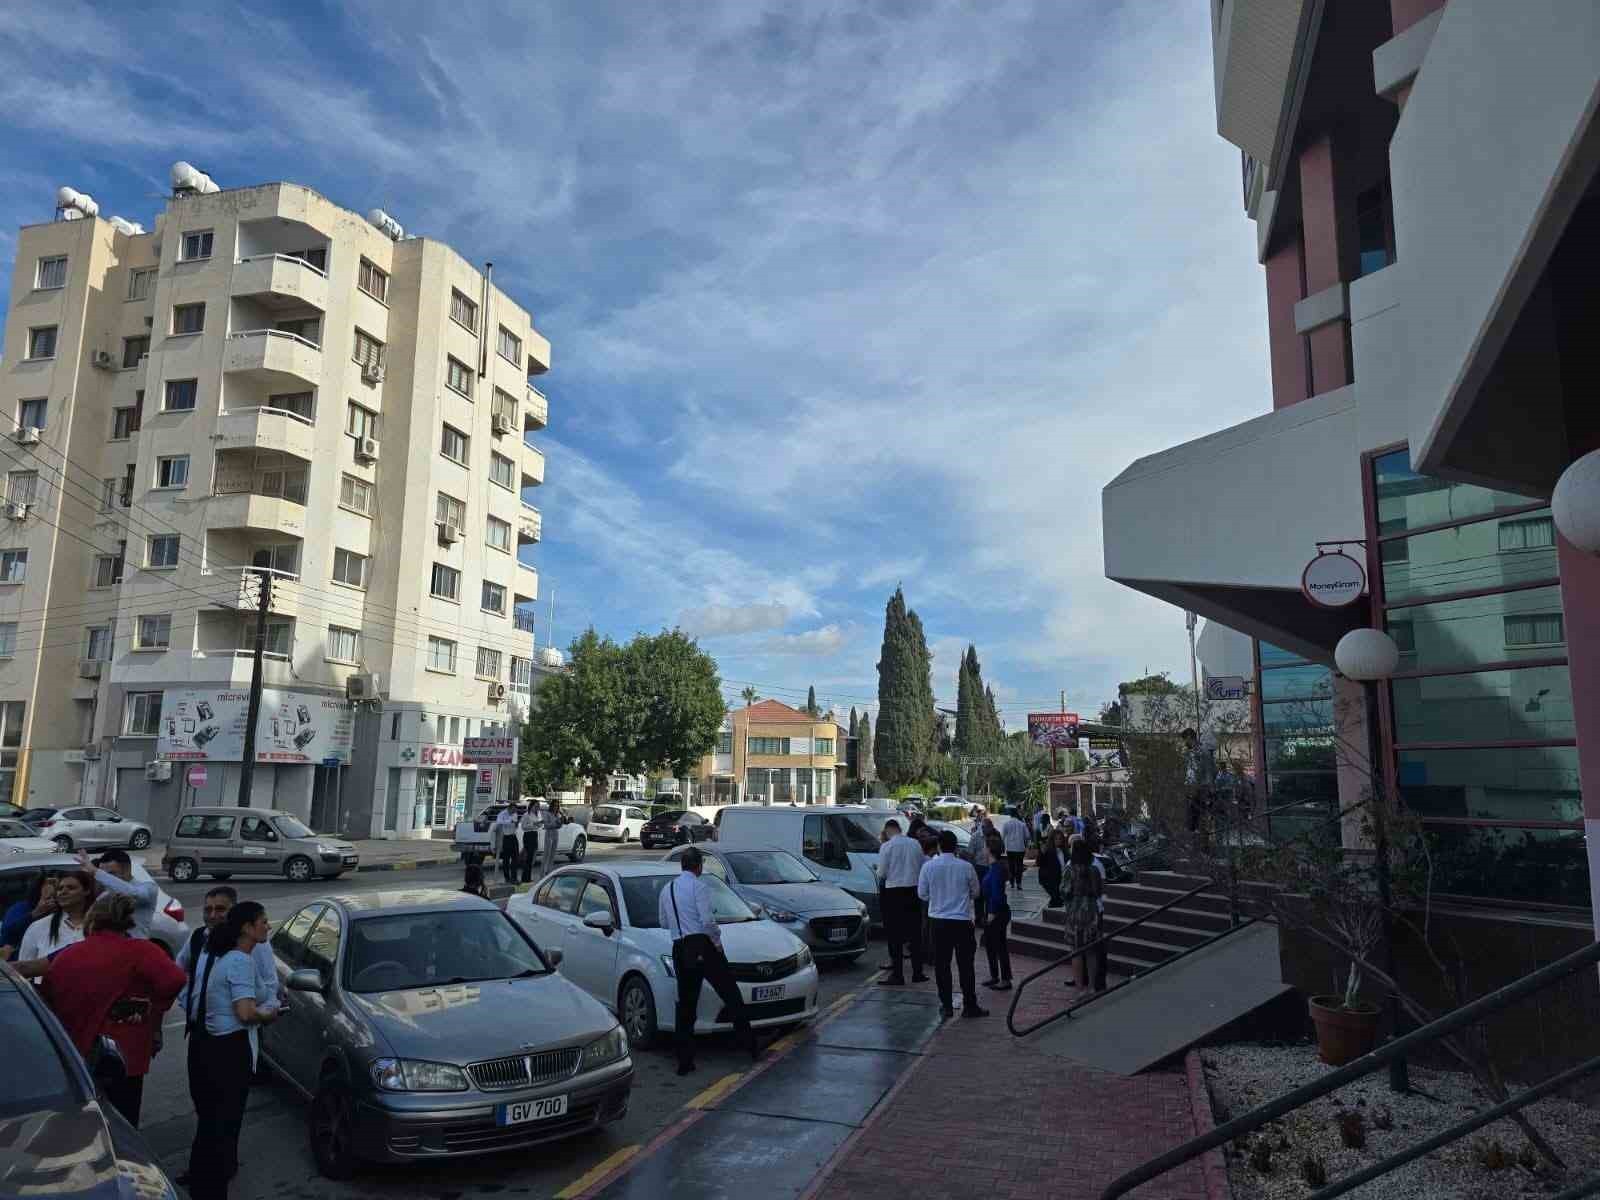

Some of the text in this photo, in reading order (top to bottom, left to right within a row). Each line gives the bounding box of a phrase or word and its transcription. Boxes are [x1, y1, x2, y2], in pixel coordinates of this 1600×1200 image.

[464, 738, 512, 748] ECZANE
[422, 747, 463, 765] ECZAN
[512, 1099, 561, 1120] GV 700
